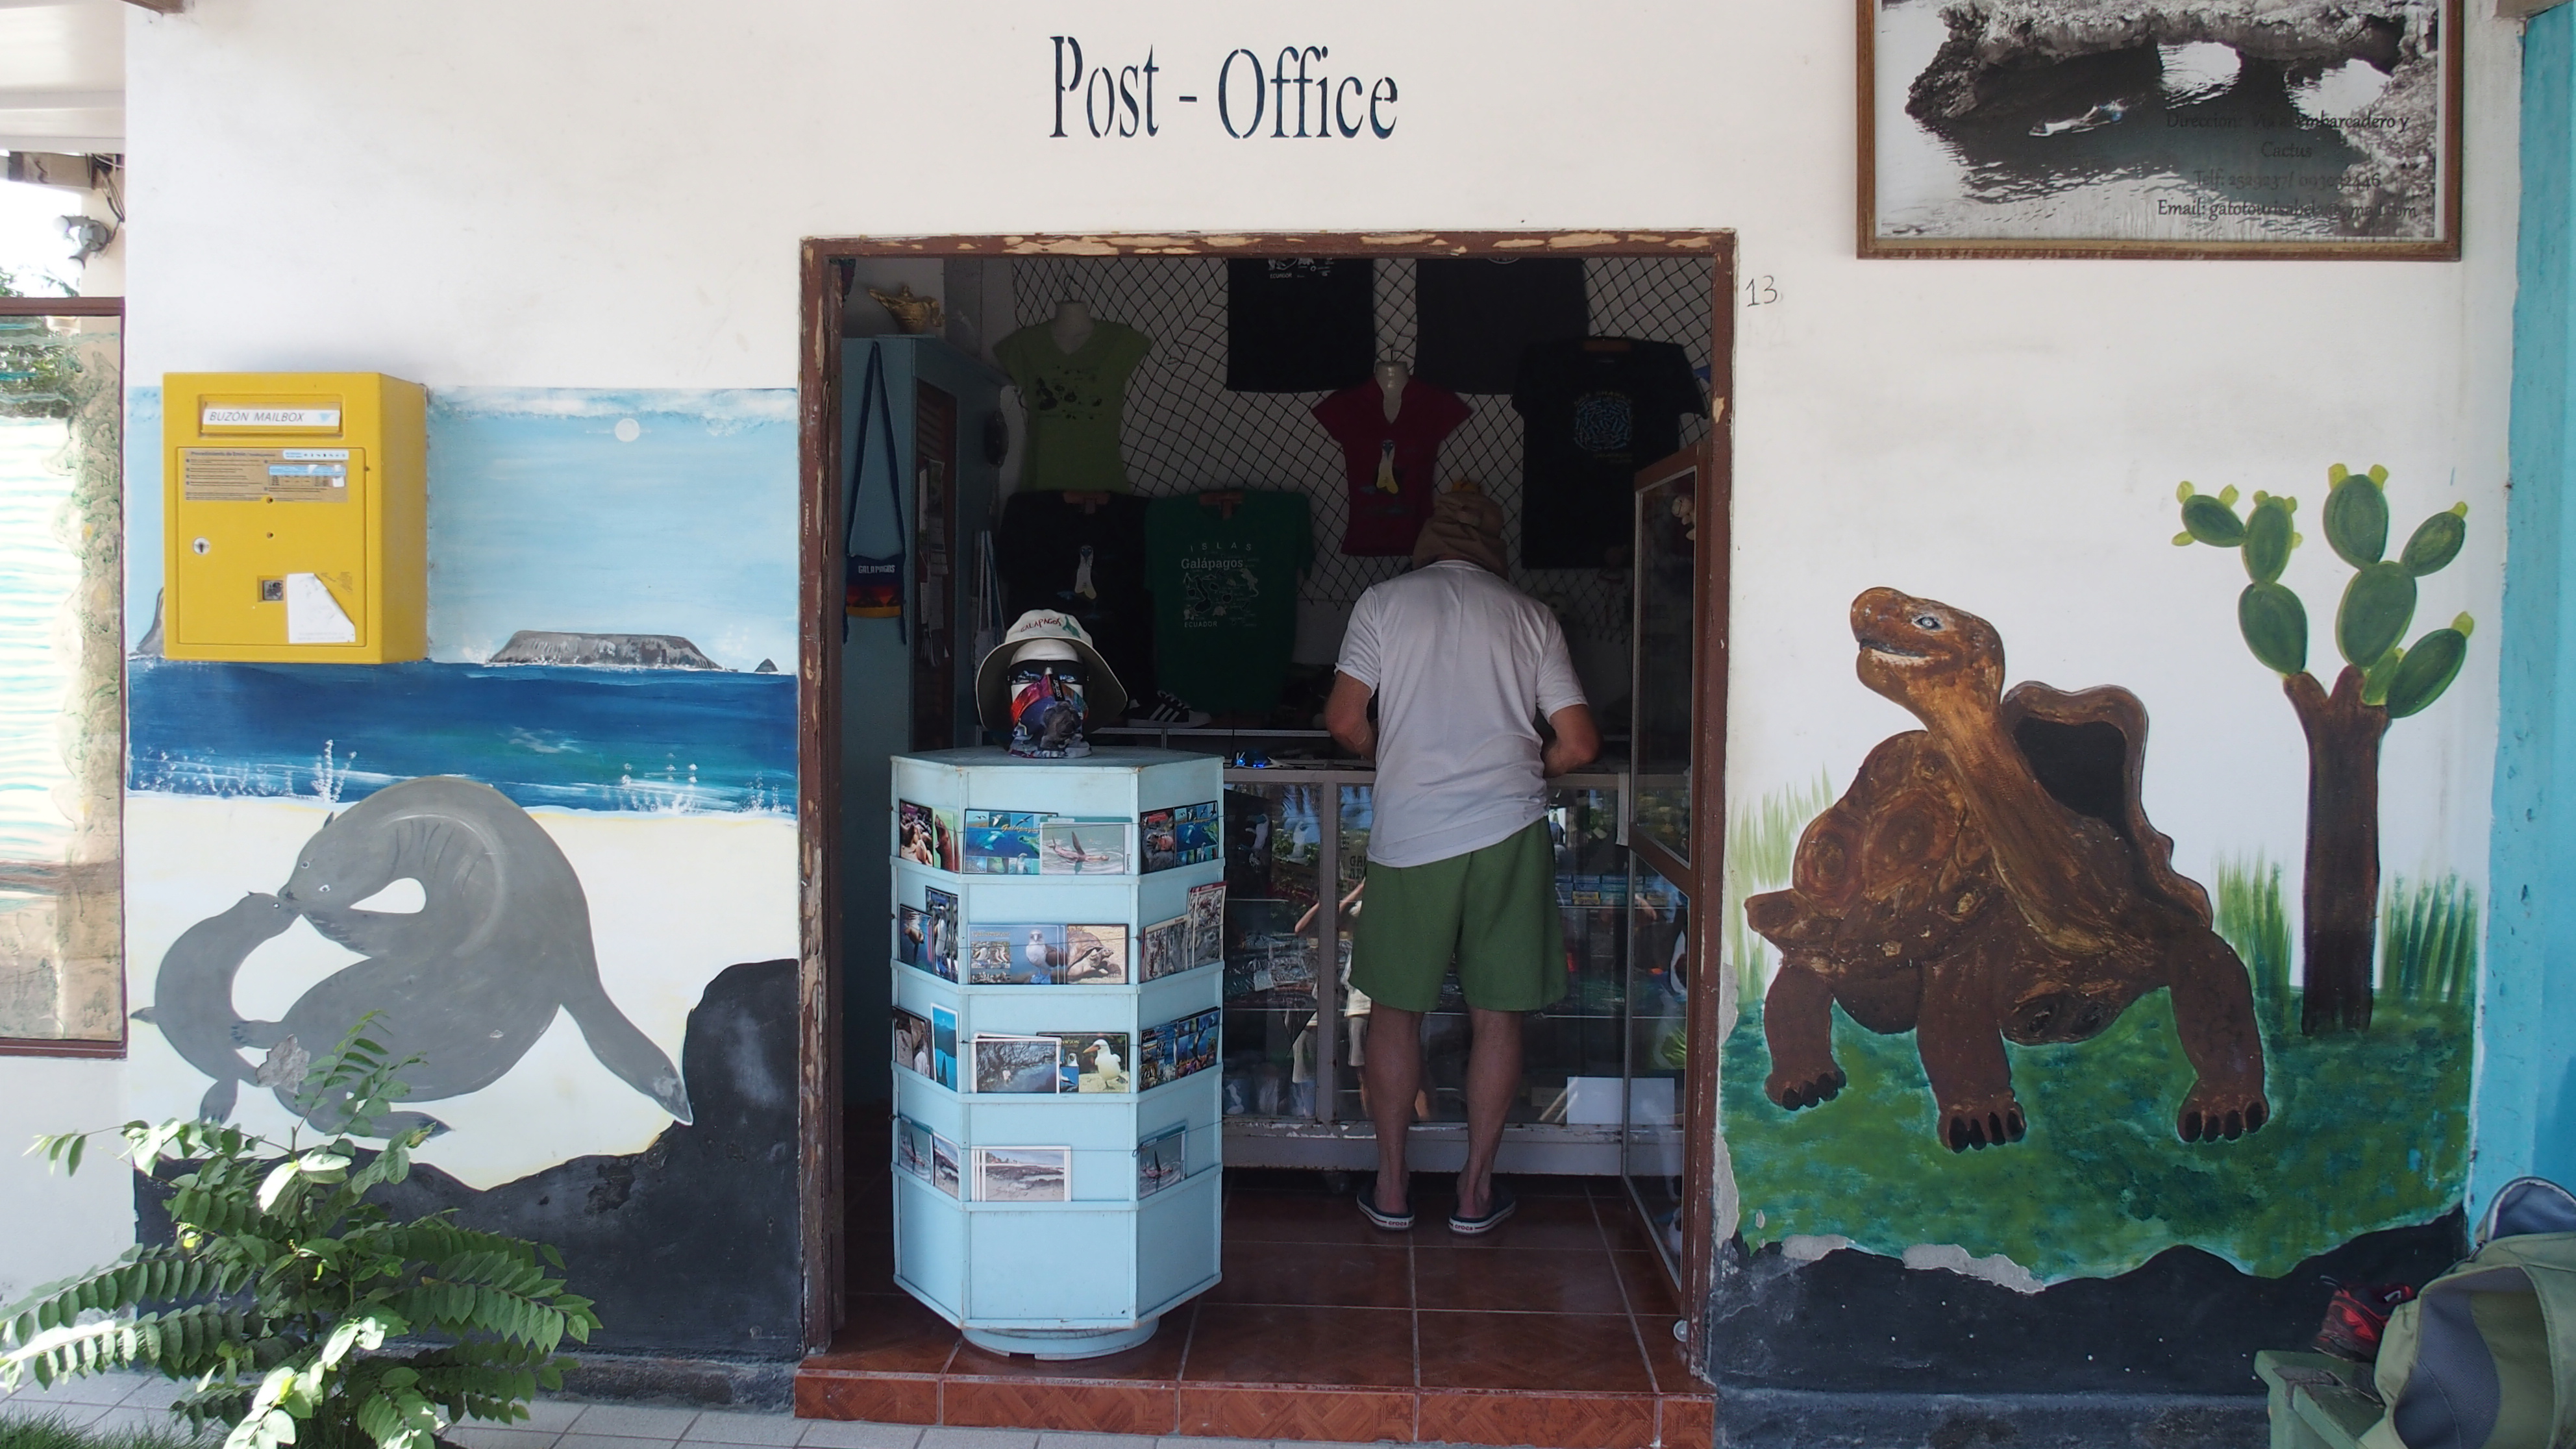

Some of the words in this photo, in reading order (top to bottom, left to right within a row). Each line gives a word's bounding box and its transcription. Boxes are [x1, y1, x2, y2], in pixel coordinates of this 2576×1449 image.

[1050, 35, 1159, 138] Post
[1218, 45, 1398, 140] Office
[2296, 109, 2396, 129] embarcadero
[2399, 117, 2410, 133] y
[2261, 141, 2312, 158] Cactus
[2194, 167, 2225, 192] Telf:
[2157, 197, 2205, 216] Email:
[1744, 275, 1778, 308] 13
[209, 410, 251, 422] BUZÓN
[253, 412, 305, 423] MAILBOX
[1190, 541, 1252, 552] ISLAS
[858, 564, 895, 574] GALAPAGOS
[1180, 556, 1244, 571] Galápagos
[1020, 617, 1062, 632] GALAPAGOS
